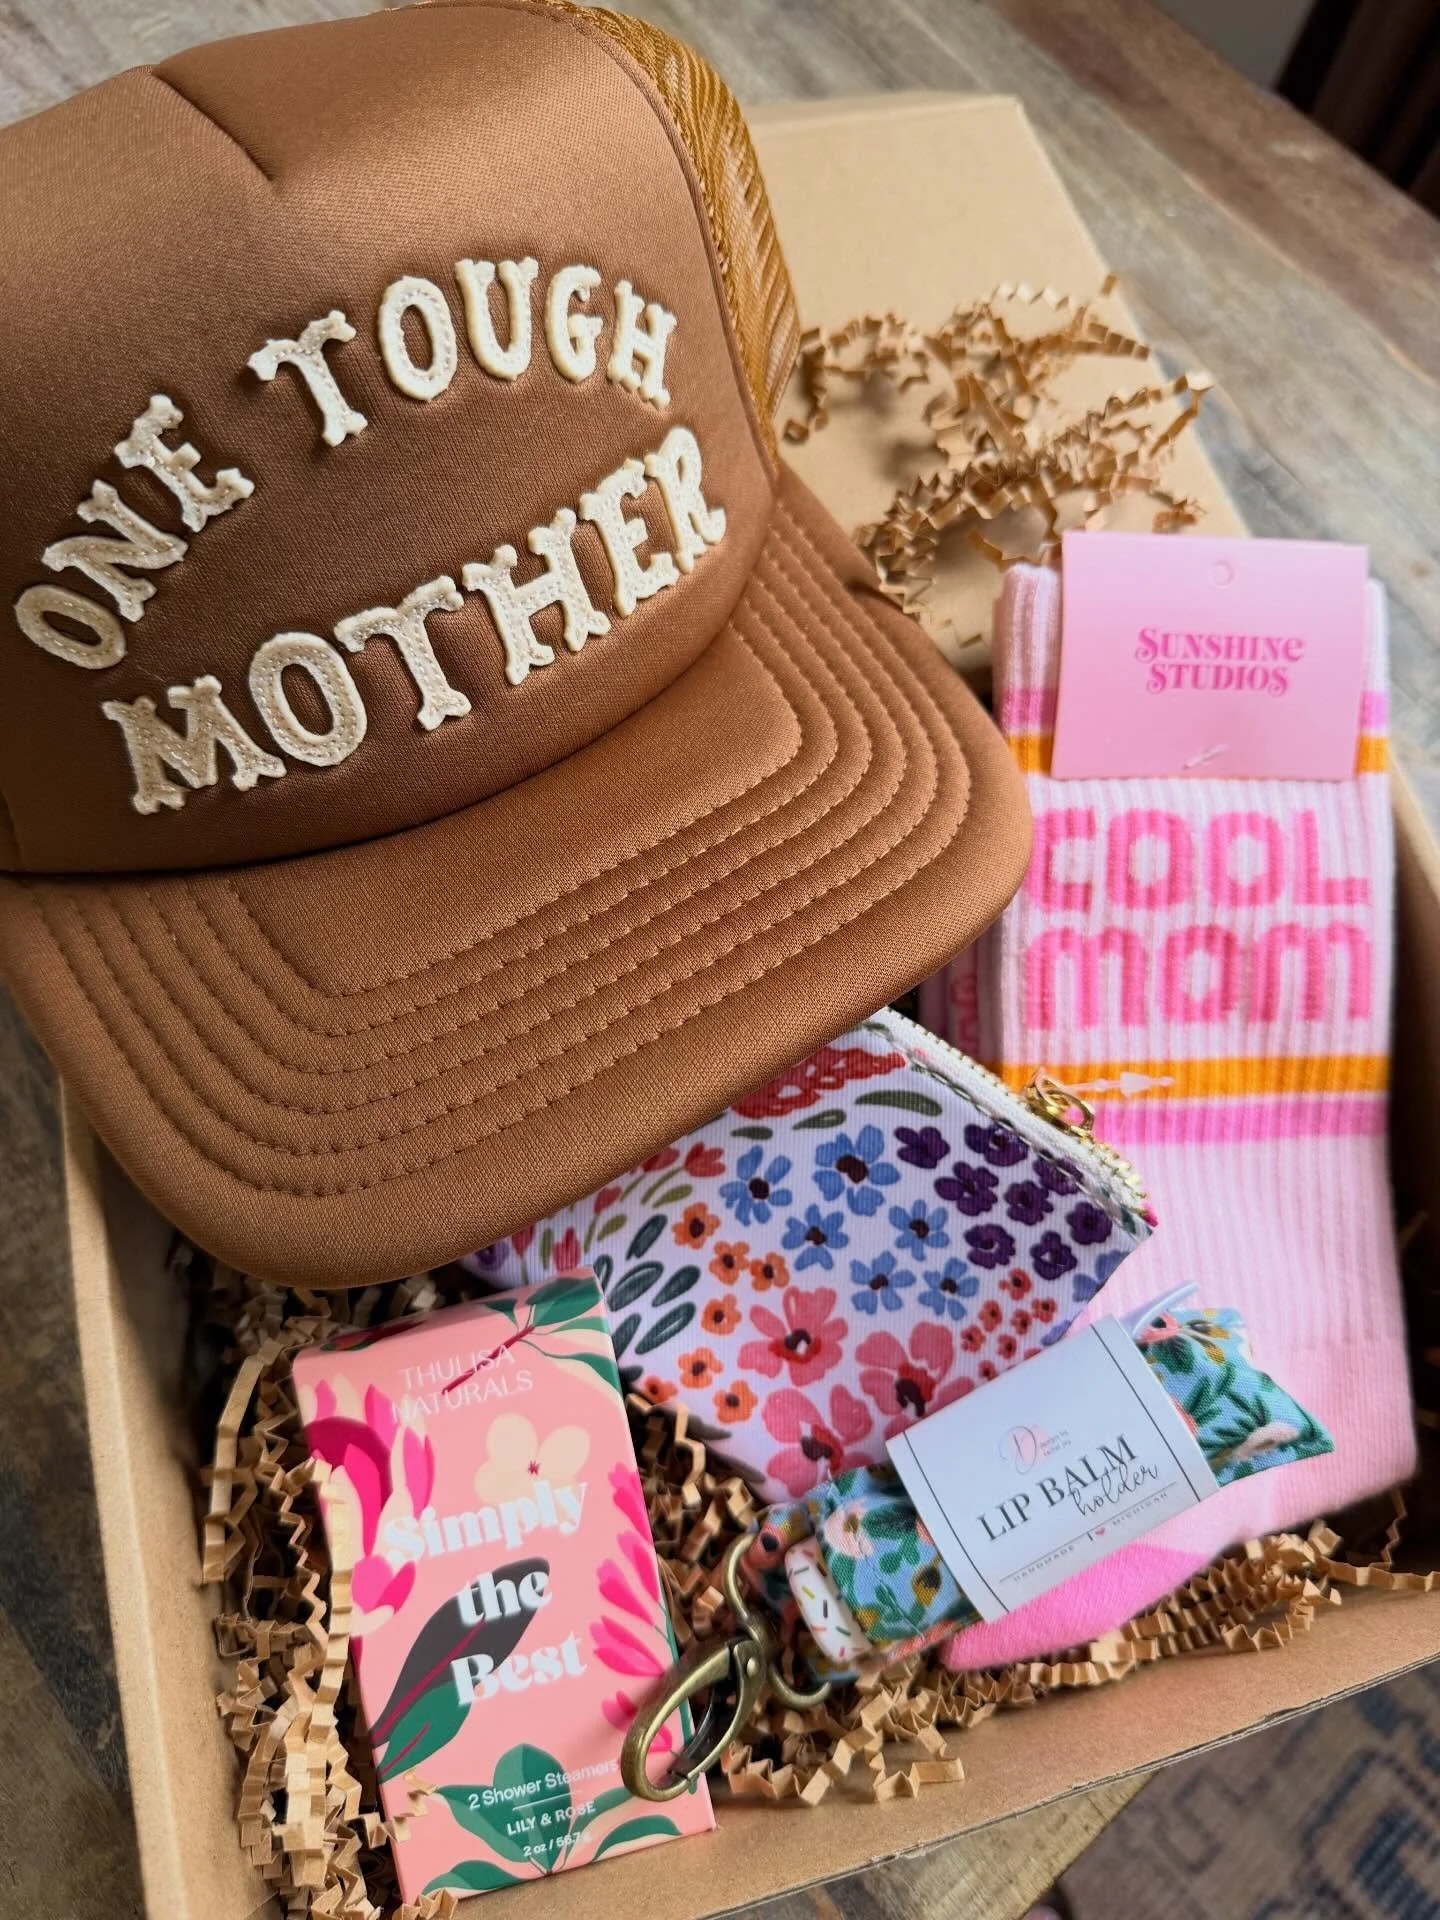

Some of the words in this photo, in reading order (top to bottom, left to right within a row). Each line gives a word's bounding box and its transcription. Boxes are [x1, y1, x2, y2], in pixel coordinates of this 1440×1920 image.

[14, 395, 254, 669] ONE
[247, 257, 677, 447] TOUGH
[102, 426, 726, 815] MOTHER
[1146, 663, 1291, 697] STUDIOS
[1022, 807, 1372, 912] COOL
[398, 1344, 516, 1391] THULISA
[391, 1369, 535, 1425] NATURALS
[977, 1492, 1032, 1542] LIP
[1036, 1434, 1138, 1508] BALM
[1068, 1460, 1159, 1516] holder
[384, 1480, 587, 1566] Simply
[457, 1571, 552, 1627] the
[450, 1632, 588, 1707] Best
[468, 1793, 480, 1810] 2
[482, 1779, 542, 1806] Shower
[544, 1760, 618, 1788] Steamers
[507, 1815, 536, 1835] LILY
[540, 1812, 552, 1827] &
[555, 1800, 596, 1823] ROSE
[523, 1845, 532, 1857] 2
[533, 1843, 547, 1854] oz
